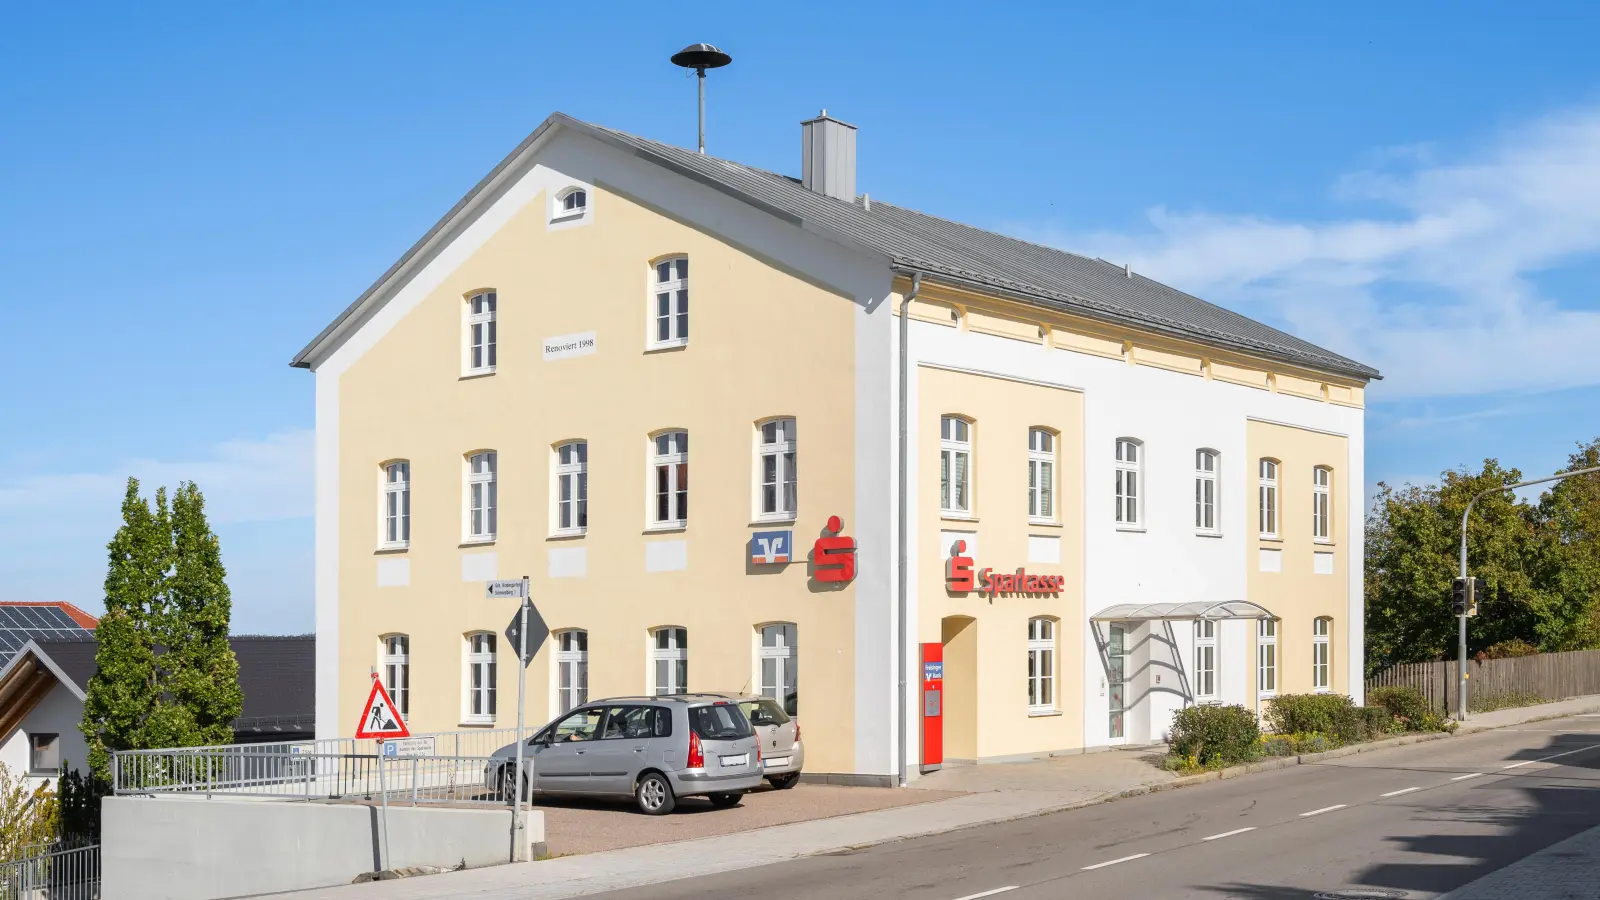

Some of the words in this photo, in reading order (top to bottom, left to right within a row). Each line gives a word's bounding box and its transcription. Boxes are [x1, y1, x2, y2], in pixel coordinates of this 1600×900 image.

[545, 342, 577, 353] Renoviert
[579, 339, 594, 348] 1998
[982, 567, 1065, 598] Sparkasse
